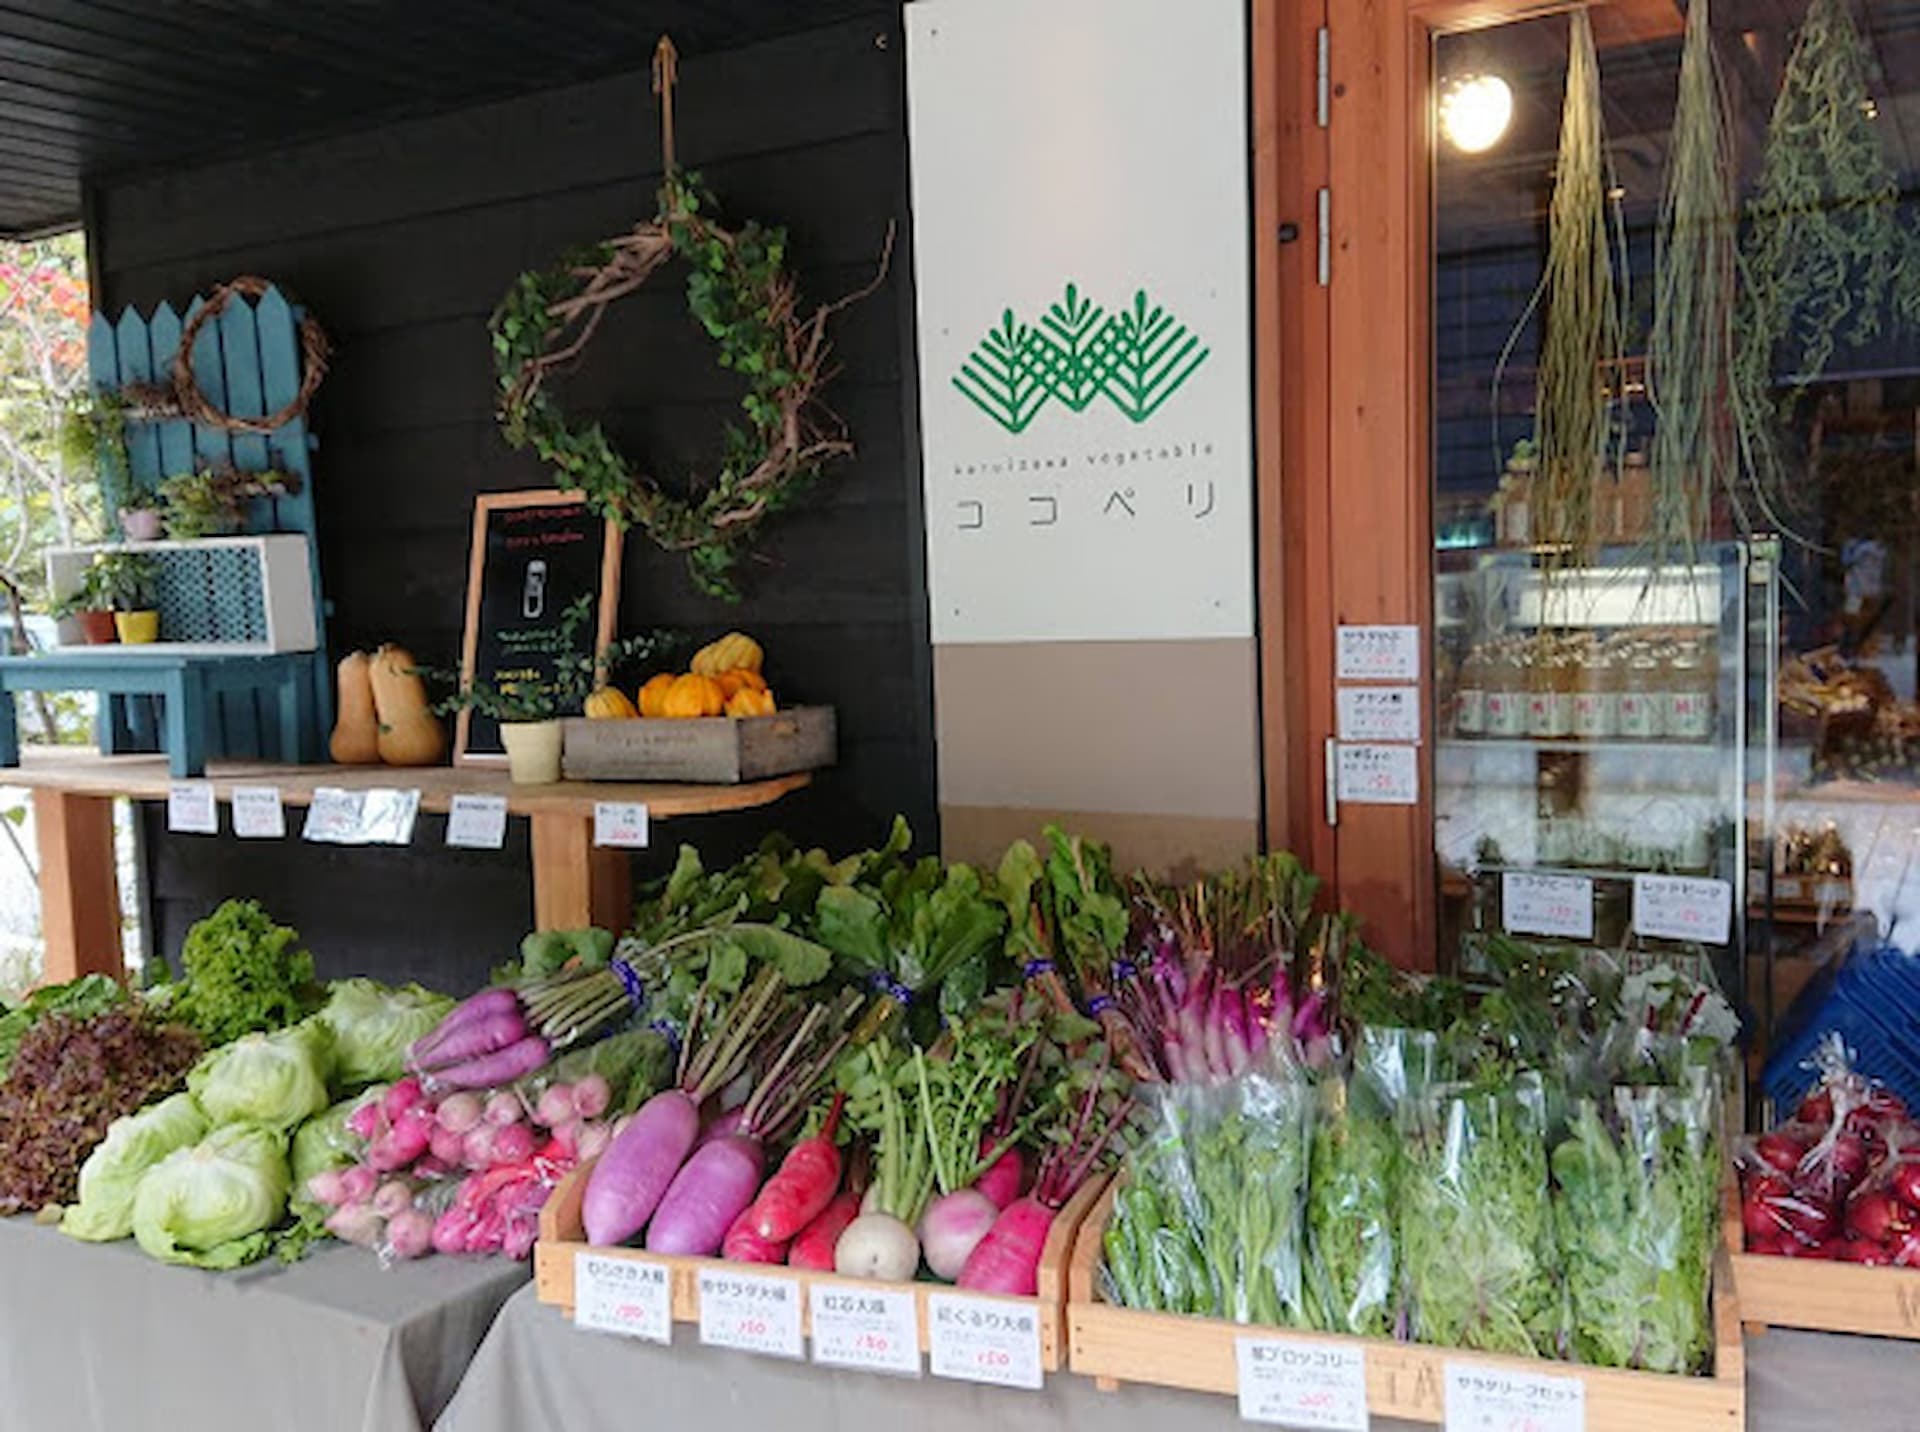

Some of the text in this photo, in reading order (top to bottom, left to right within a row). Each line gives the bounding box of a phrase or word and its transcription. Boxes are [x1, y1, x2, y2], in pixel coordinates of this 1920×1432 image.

[1086, 443, 1213, 466] vegetable
[957, 480, 1214, 529] ココペリ
